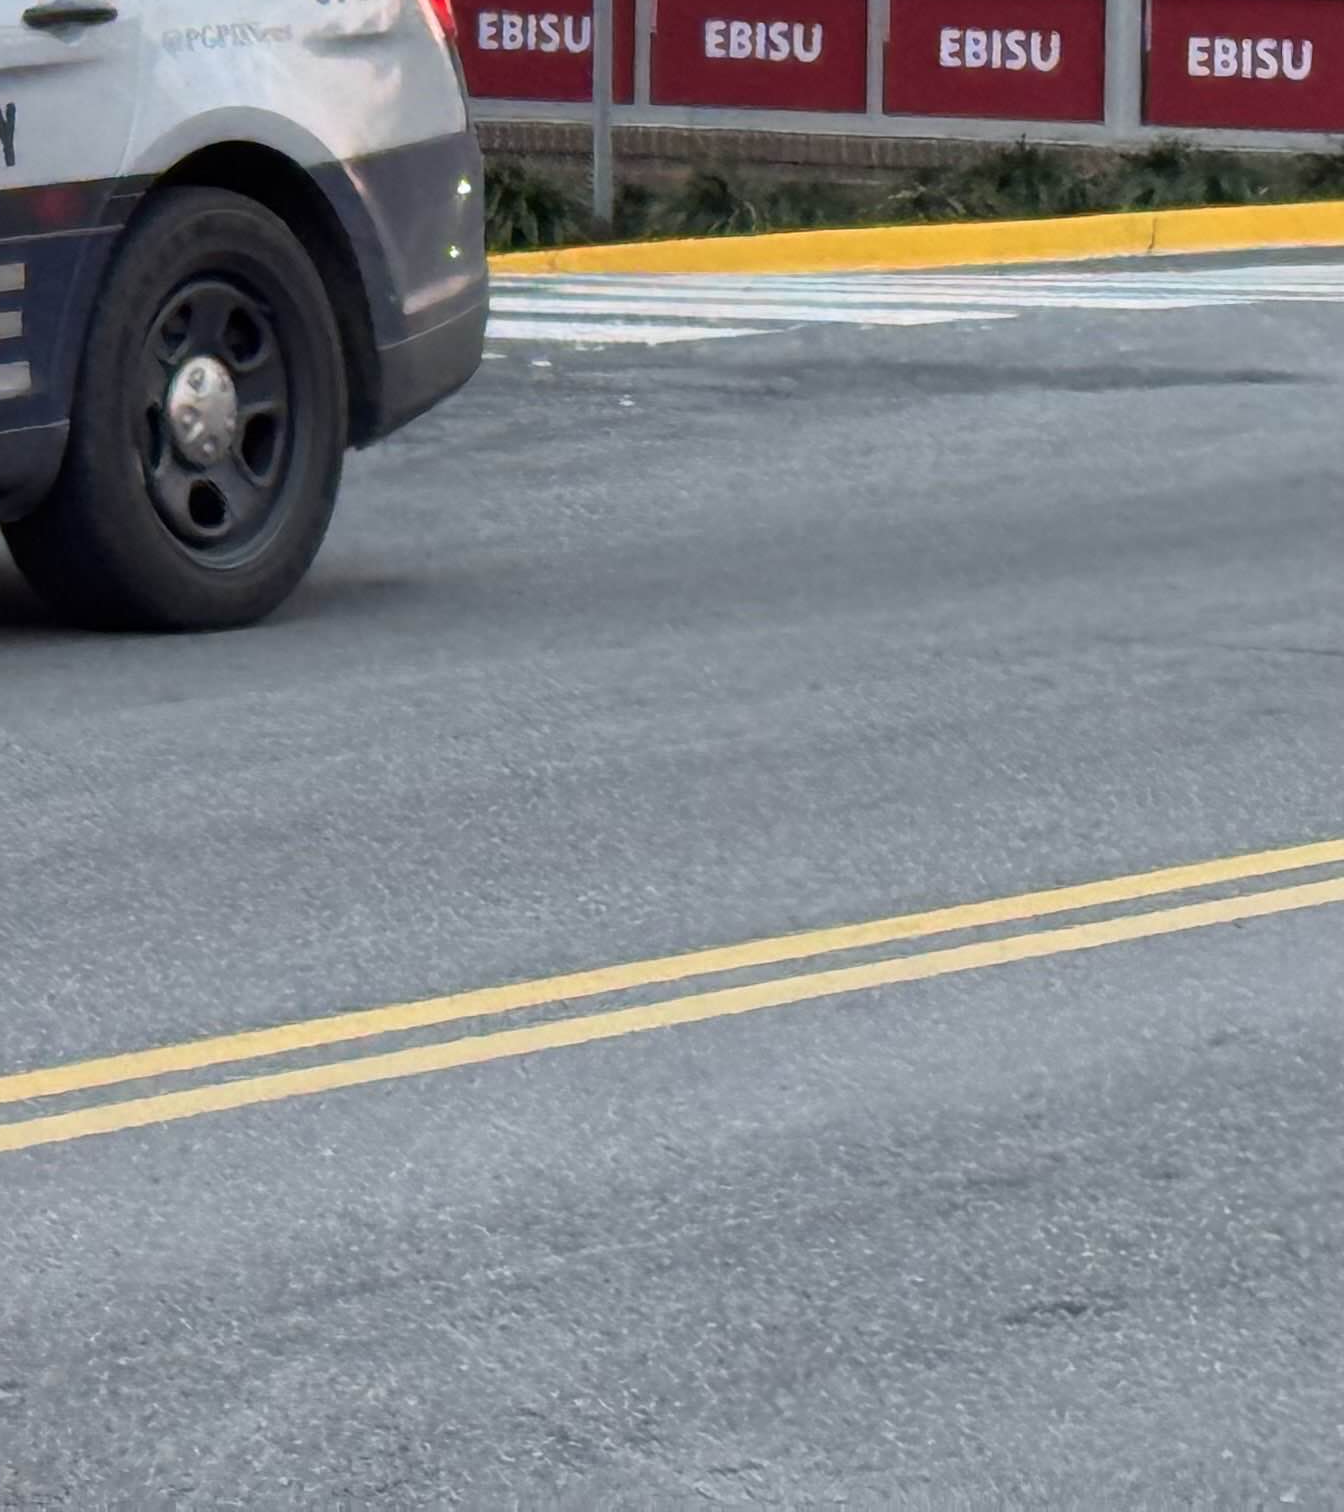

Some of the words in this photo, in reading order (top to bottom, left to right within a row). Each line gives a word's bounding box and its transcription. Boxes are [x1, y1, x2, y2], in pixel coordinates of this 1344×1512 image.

[478, 12, 592, 54] EBISU
[705, 20, 823, 63] EBISU
[939, 28, 1061, 72] EBISU
[1187, 36, 1313, 80] EBISU
